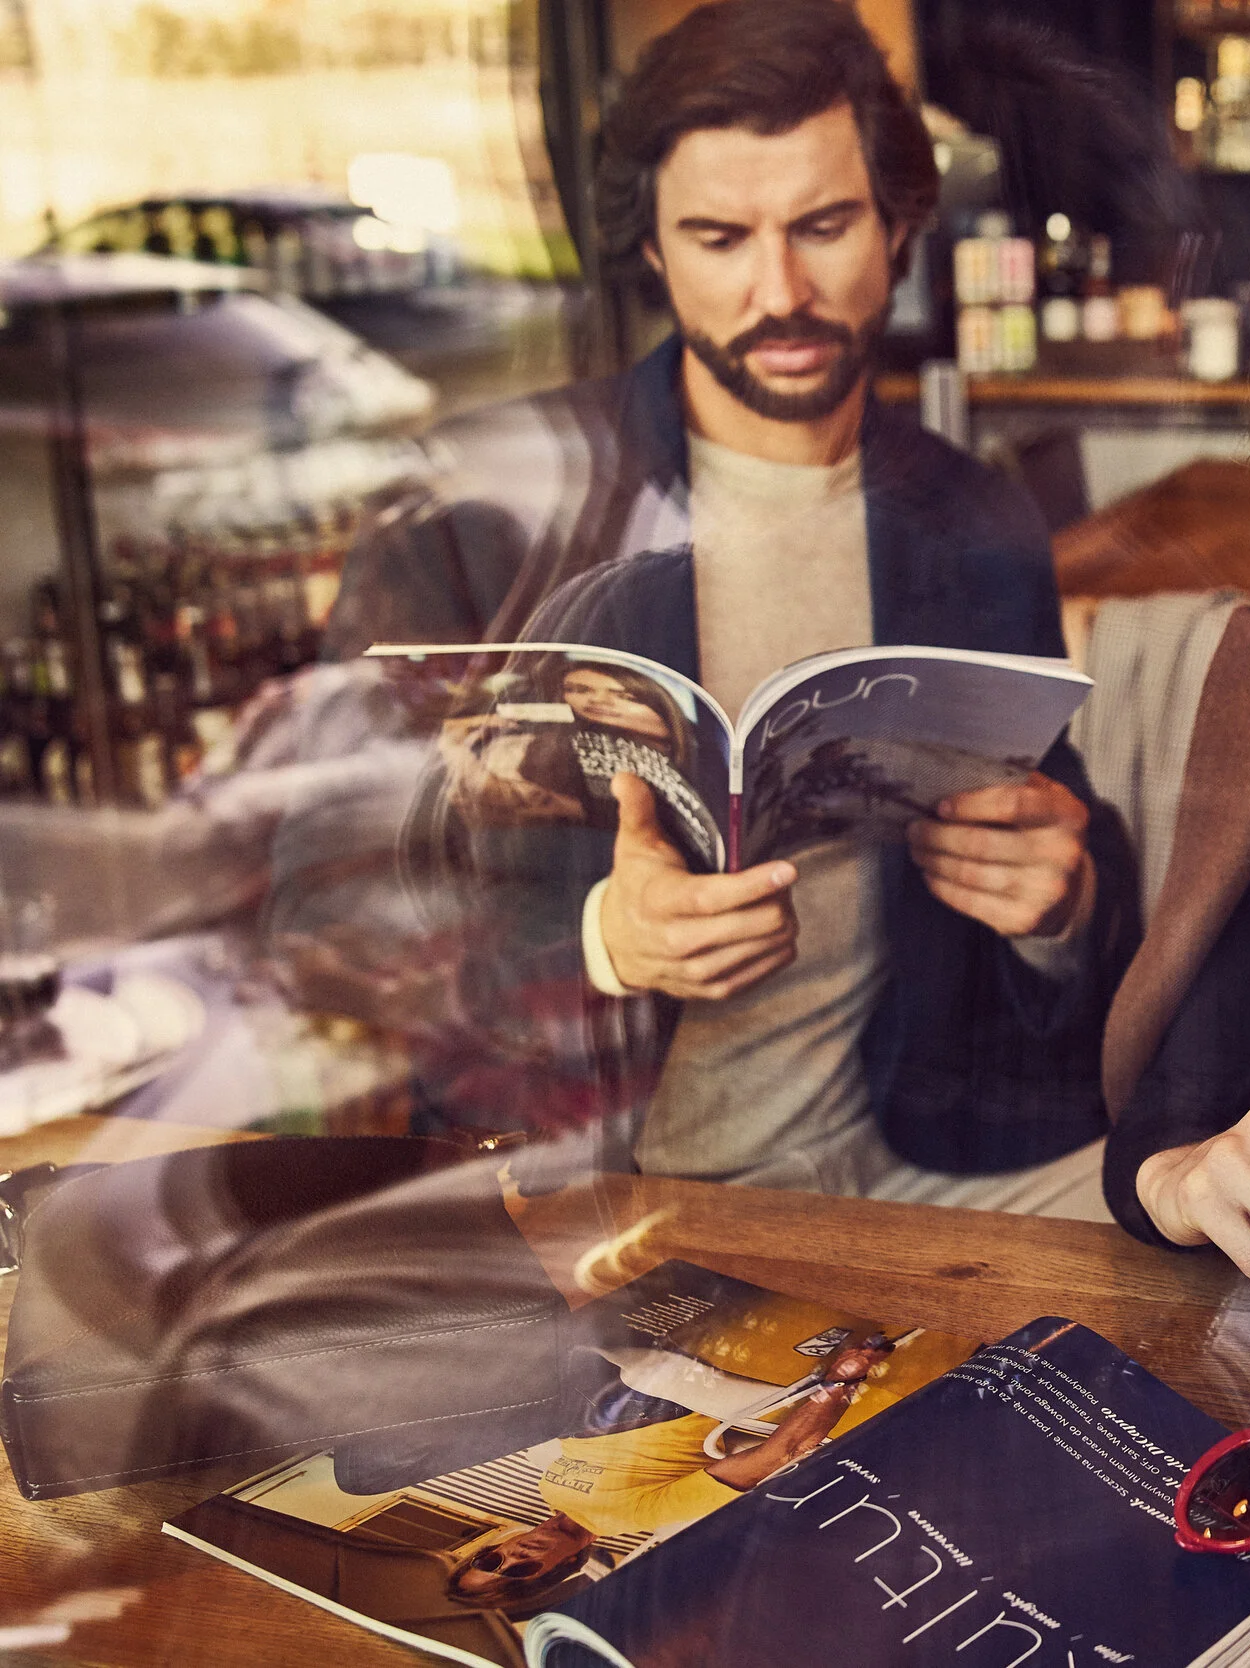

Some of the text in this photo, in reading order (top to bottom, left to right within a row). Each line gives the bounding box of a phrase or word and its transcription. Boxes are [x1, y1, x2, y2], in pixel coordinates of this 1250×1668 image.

[1018, 1348, 1040, 1362] tylko
[1040, 1360, 1055, 1371] nie
[975, 1378, 991, 1388] go
[988, 1385, 1000, 1394] to
[1055, 1369, 1099, 1406] Pojedynek
[999, 1392, 1012, 1403] Za
[1037, 1376, 1094, 1425] Transatlantyk
[1027, 1414, 1050, 1433] poza
[1034, 1396, 1070, 1427] Nowego
[1069, 1425, 1082, 1436] do
[1096, 1422, 1121, 1446] Wave,
[1101, 1407, 1165, 1456] DiCaprio
[1053, 1436, 1082, 1461] scenie
[1081, 1434, 1109, 1459] wraca
[1121, 1445, 1140, 1460] Salt
[837, 1459, 881, 1484] serial
[1081, 1459, 1095, 1470] na
[1109, 1457, 1141, 1484] filmem
[1140, 1457, 1160, 1475] OFF,
[1093, 1469, 1129, 1498] Szczery
[1141, 1482, 1175, 1507] Nowym
[907, 1510, 973, 1567] literatura
[1002, 1591, 1061, 1629] muzyka
